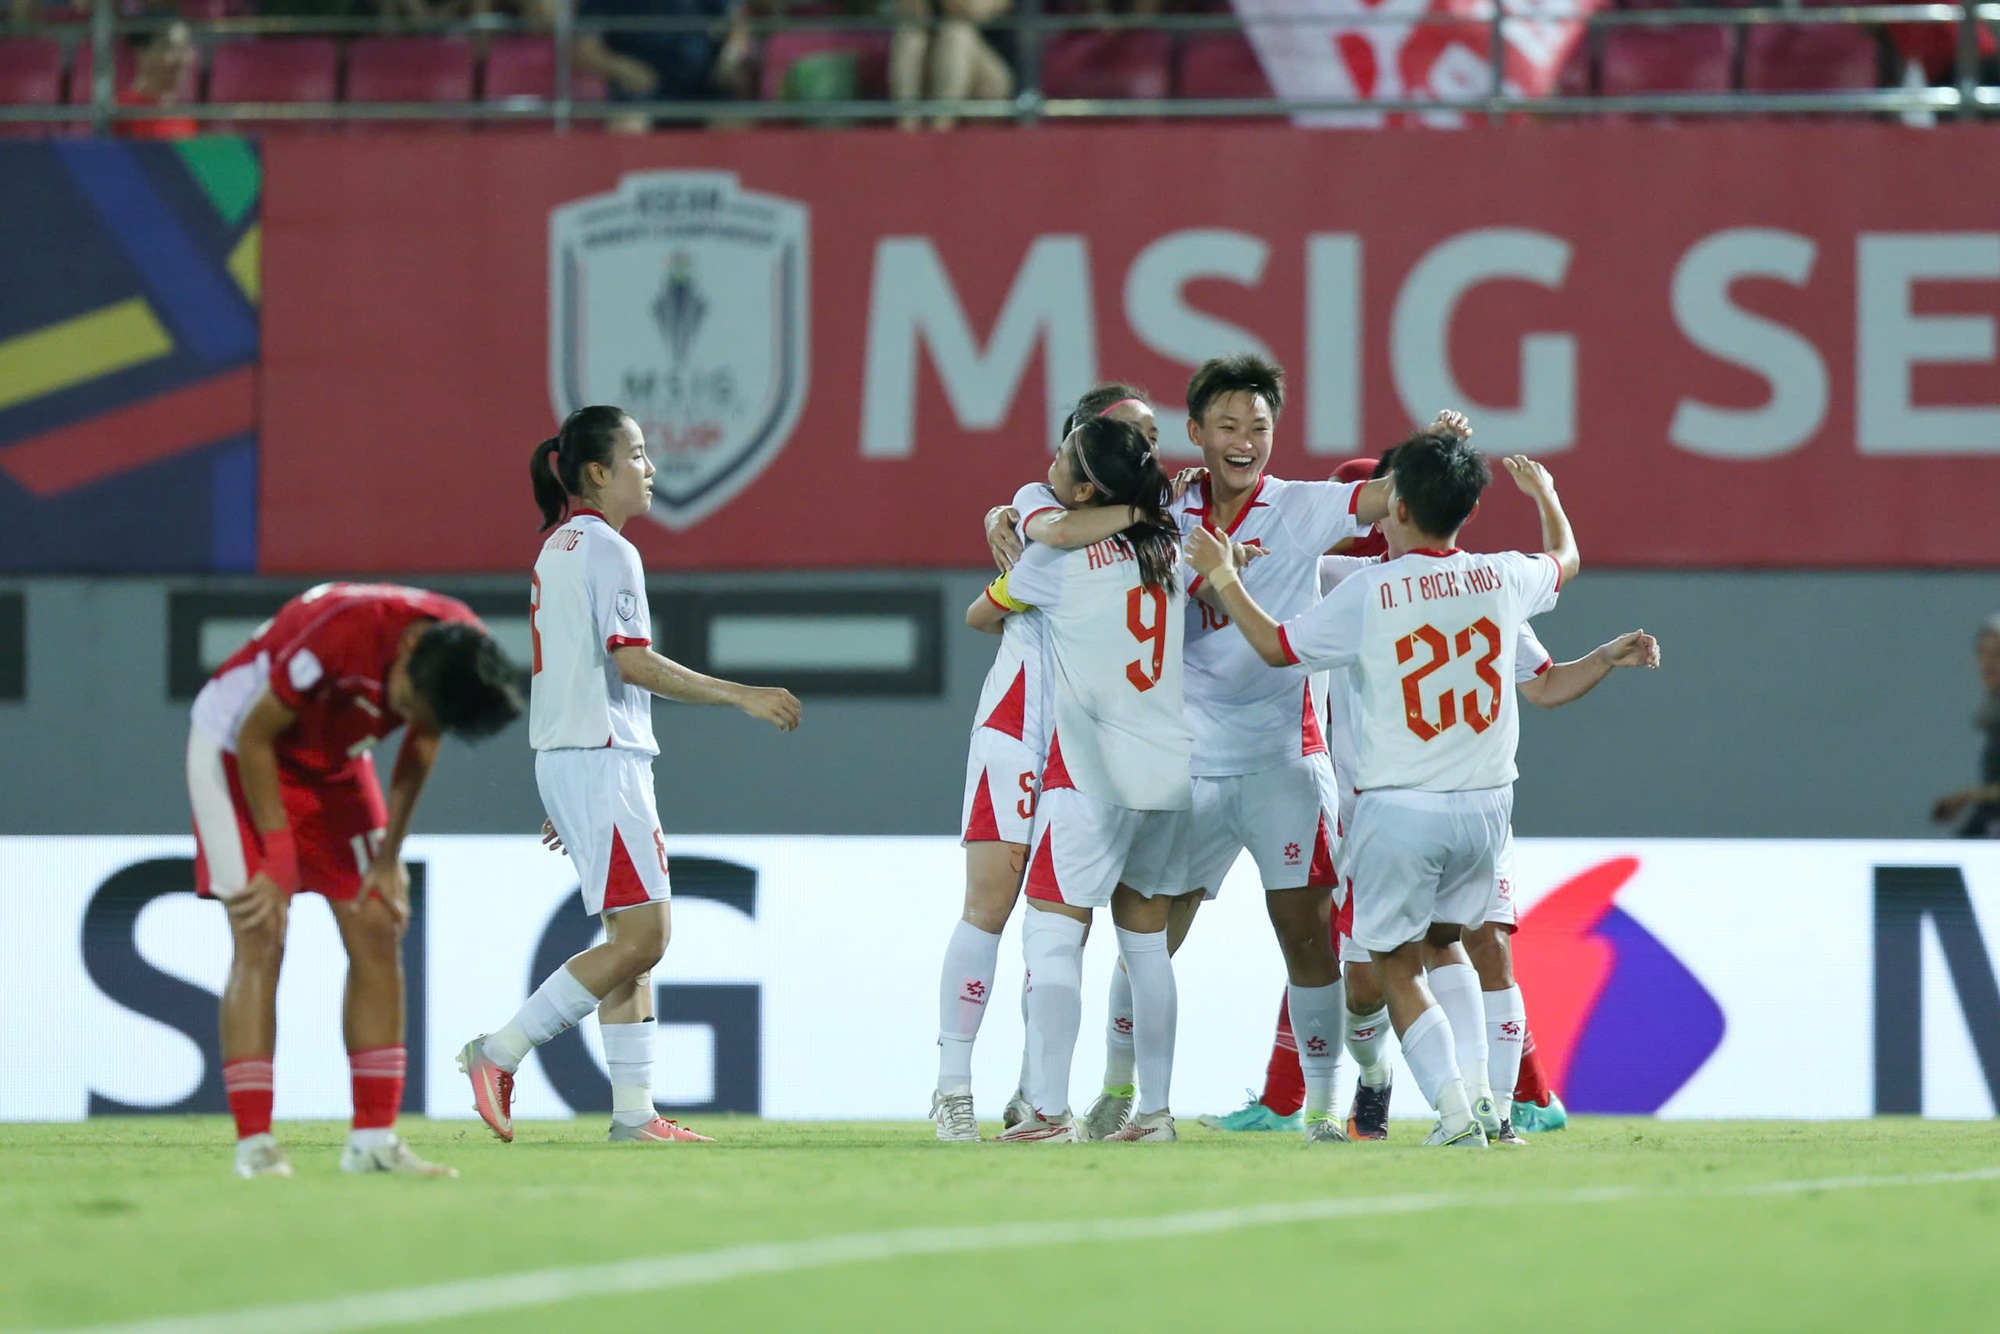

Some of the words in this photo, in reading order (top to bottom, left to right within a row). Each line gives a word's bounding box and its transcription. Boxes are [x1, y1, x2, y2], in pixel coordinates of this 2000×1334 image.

[860, 228, 1578, 458] MSIG
[1668, 227, 2000, 458] SE
[1126, 582, 1167, 693] 9
[1419, 571, 1459, 601] BICH
[1395, 616, 1502, 742] 23
